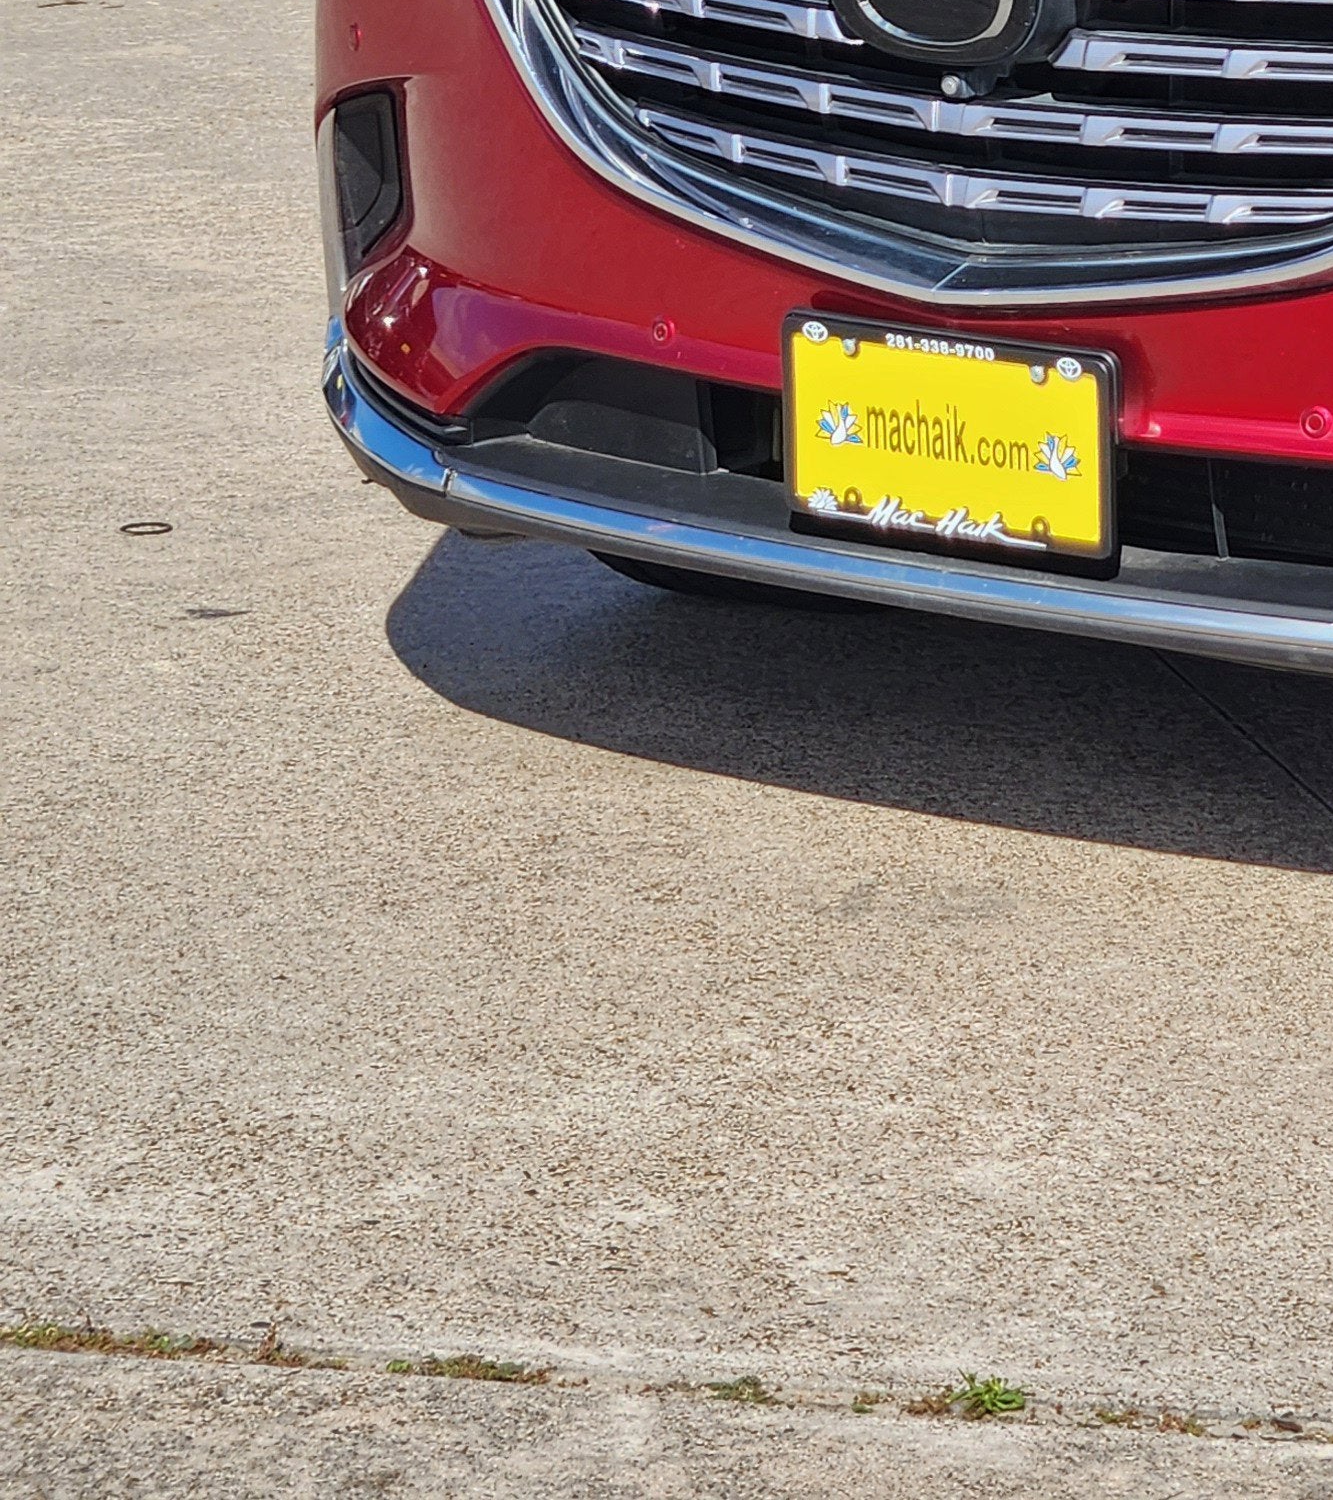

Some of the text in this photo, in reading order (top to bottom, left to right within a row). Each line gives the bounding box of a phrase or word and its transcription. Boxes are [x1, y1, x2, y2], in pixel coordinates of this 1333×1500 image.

[884, 332, 996, 362] 281-338-9700
[865, 399, 1031, 472] machaik.com
[866, 495, 932, 529] Mac
